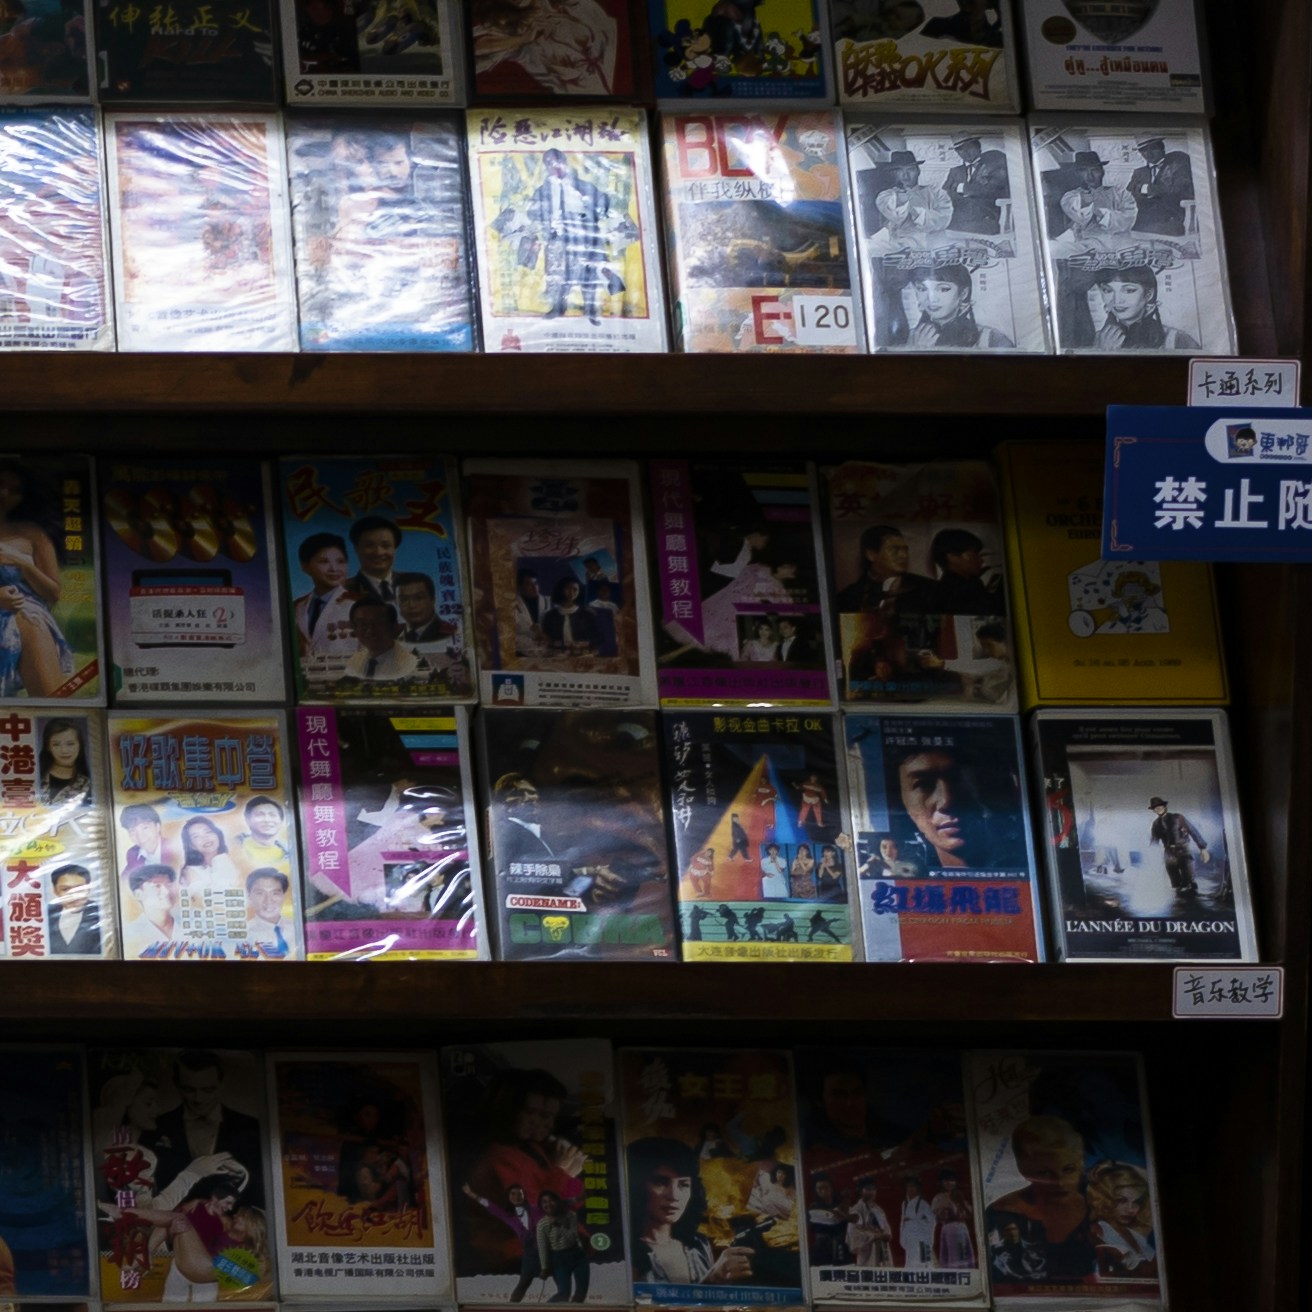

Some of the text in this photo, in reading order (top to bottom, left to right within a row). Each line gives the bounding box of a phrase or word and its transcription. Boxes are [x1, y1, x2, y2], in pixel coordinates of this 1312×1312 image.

[800, 303, 850, 330] 120
[1197, 367, 1283, 398] 卡通系列
[284, 463, 453, 538] 民歌王
[804, 719, 823, 732] OK
[302, 713, 342, 870] 現代舞廳舞教程
[1066, 916, 1235, 934] L'ANNÉE DU DRAGON
[1183, 974, 1275, 1007] 音乐教学
[291, 1252, 436, 1266] 湖北音像艺术出版社出版
